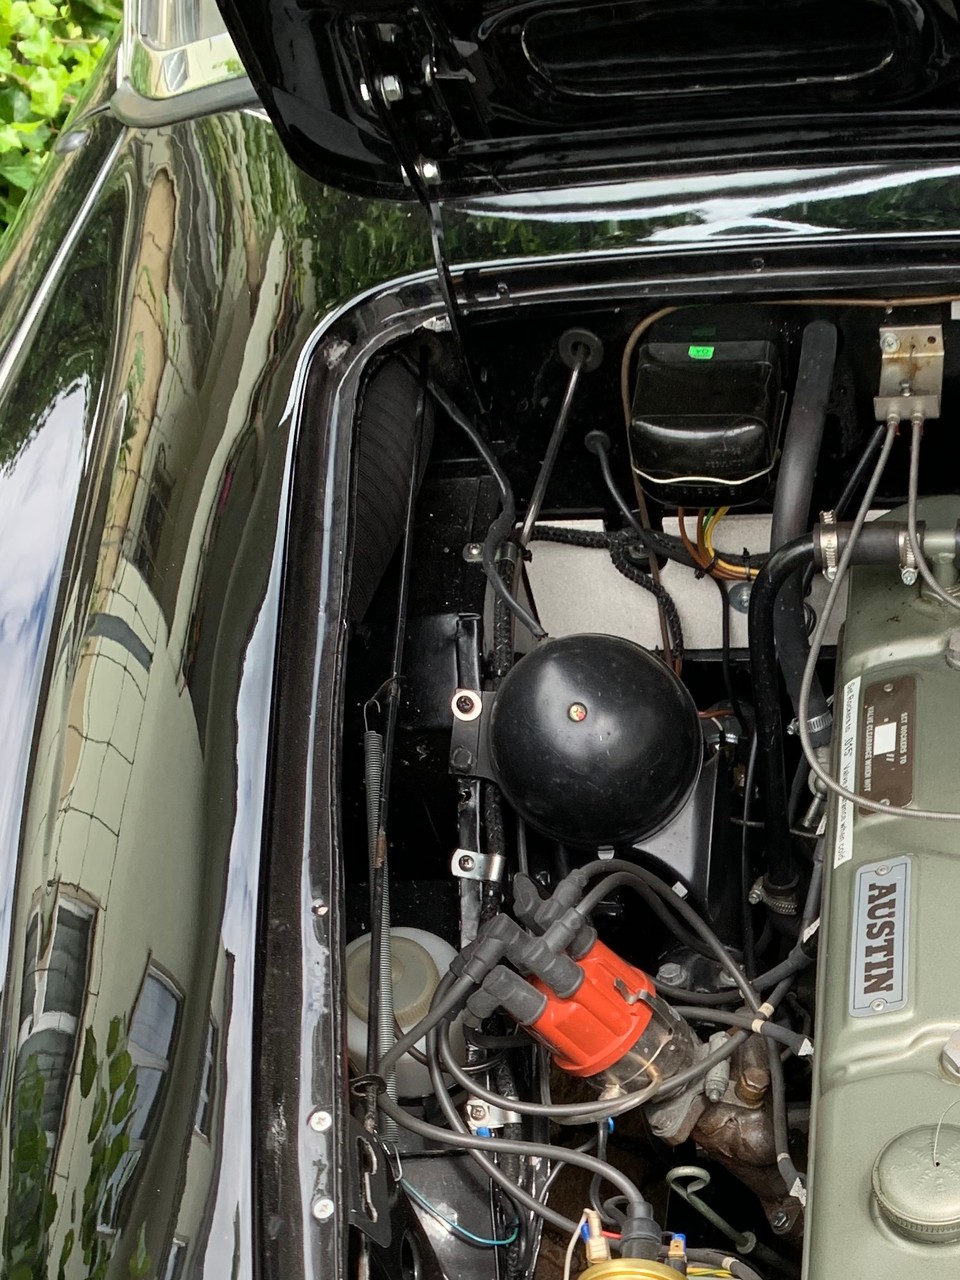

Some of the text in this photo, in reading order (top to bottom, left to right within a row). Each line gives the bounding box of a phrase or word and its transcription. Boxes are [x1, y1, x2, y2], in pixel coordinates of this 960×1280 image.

[866, 706, 874, 725] VALVE
[865, 725, 873, 760] CLEARANCE
[900, 724, 908, 754] ROCKERS
[864, 759, 872, 778] WHEN
[899, 755, 907, 765] TO
[863, 882, 897, 995] AUSTIN
